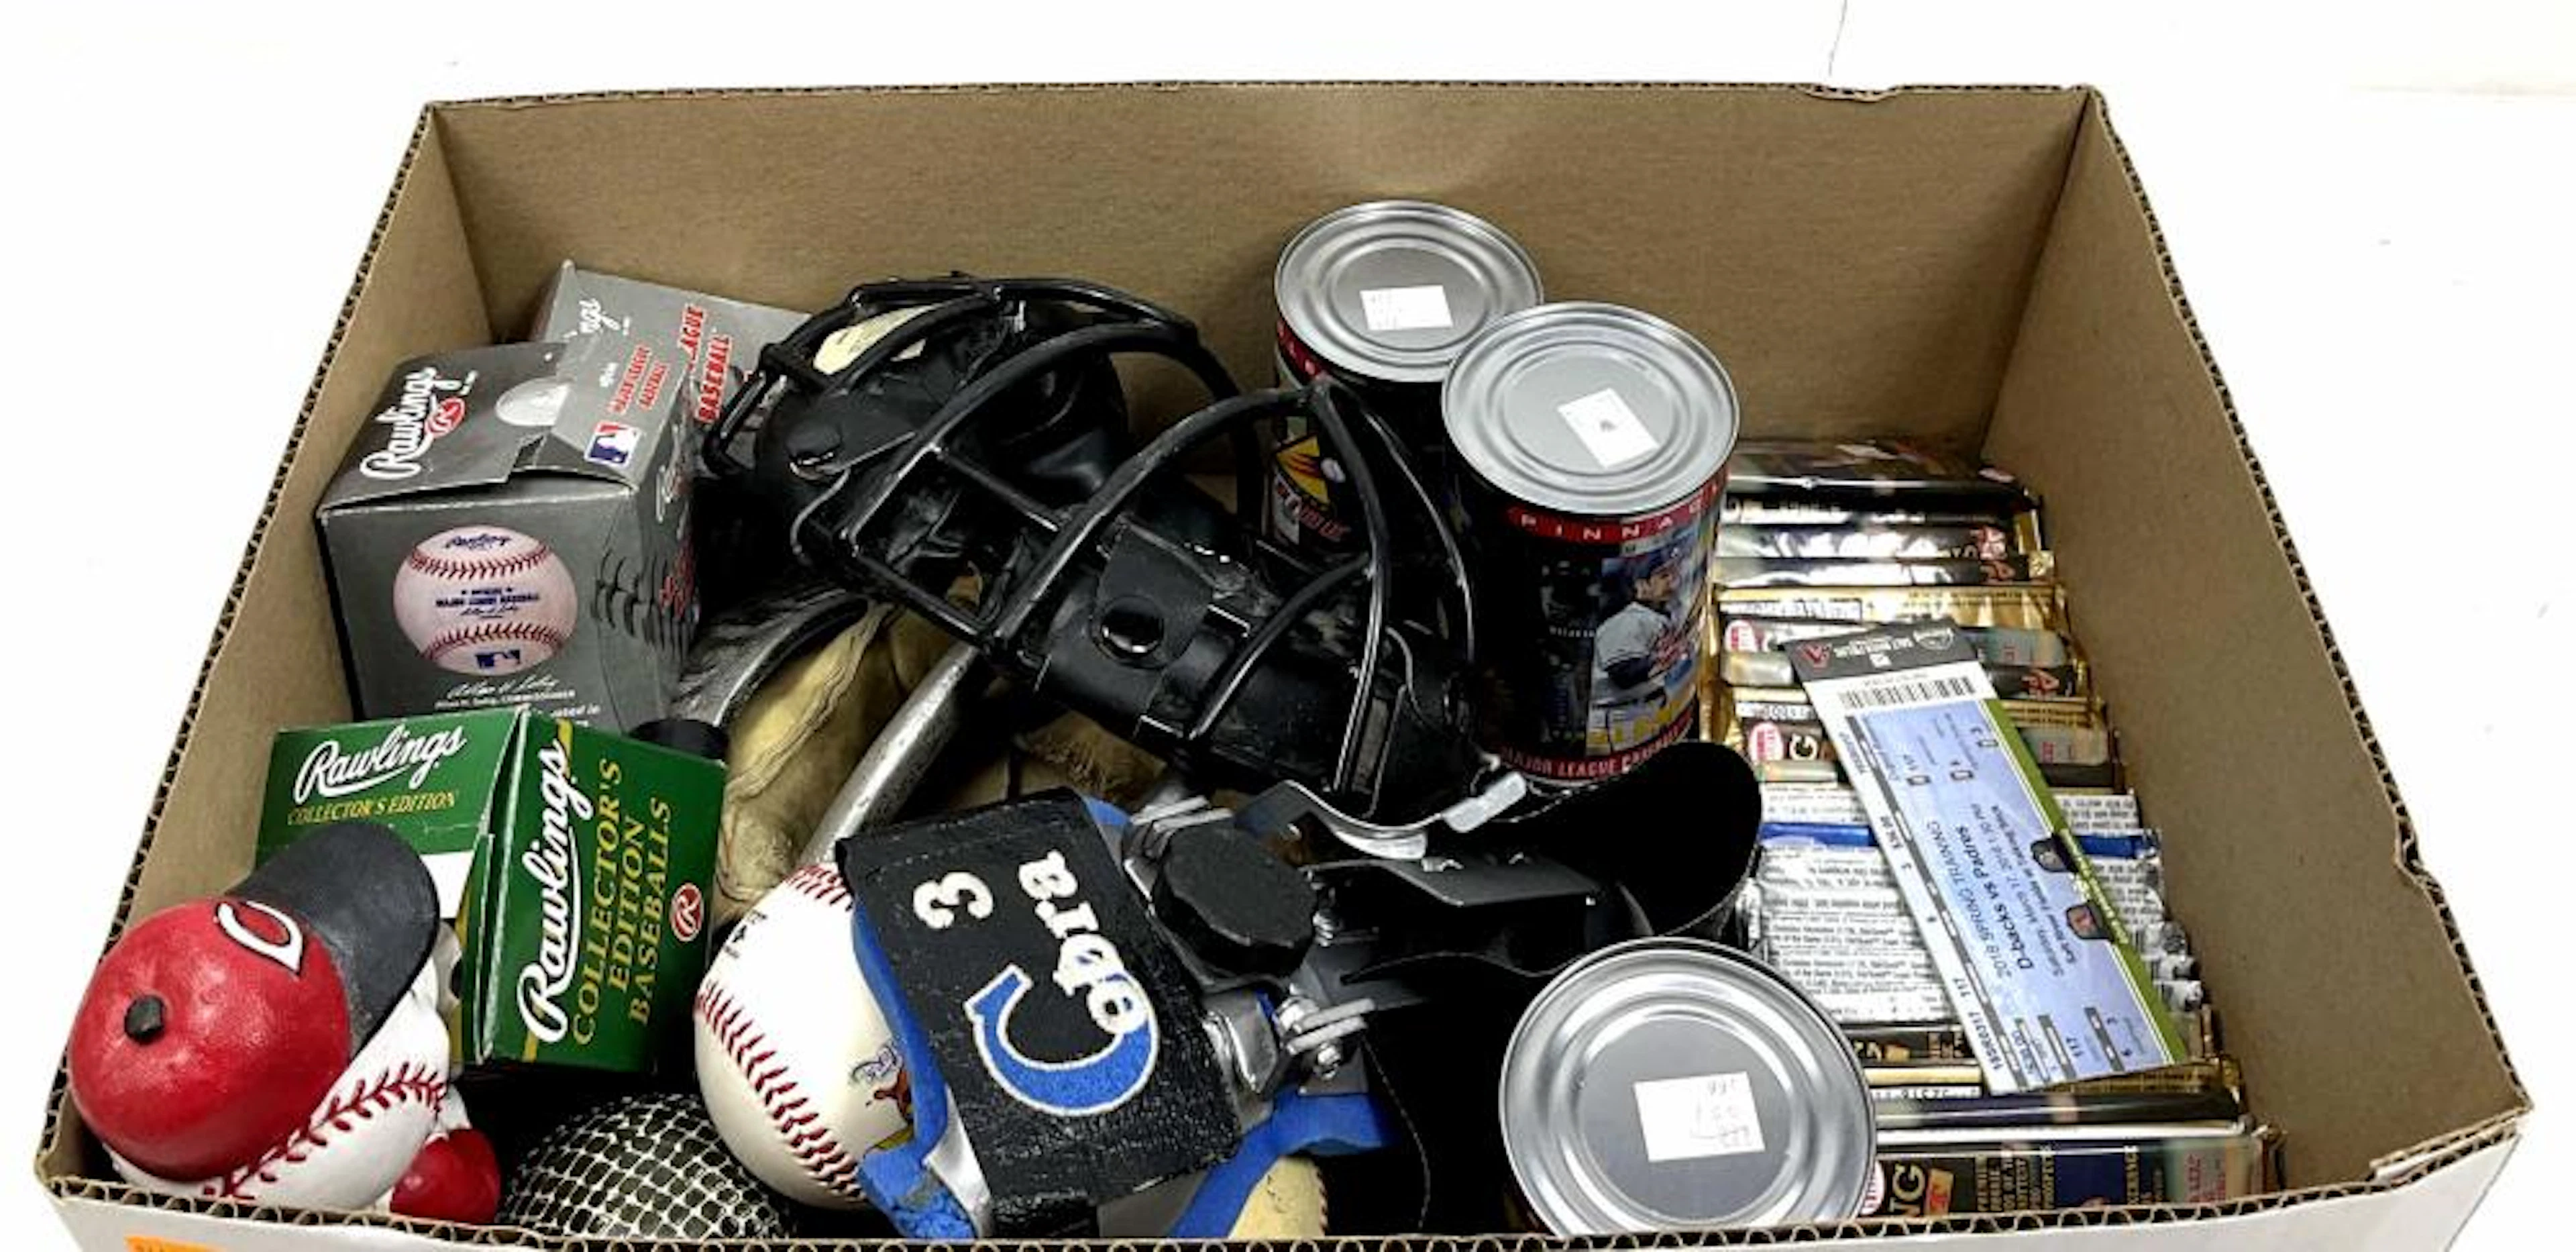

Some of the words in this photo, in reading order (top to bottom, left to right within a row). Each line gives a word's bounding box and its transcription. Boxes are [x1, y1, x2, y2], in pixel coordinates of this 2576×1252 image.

[696, 336, 731, 423] BASEBALL
[360, 367, 464, 480] Rawlings
[293, 724, 468, 804] Rawlings
[286, 796, 387, 826] COLLECTOR'S
[388, 790, 455, 815] EDITION
[517, 738, 594, 1043] Rawlings
[1923, 819, 1968, 885] TRAINING
[1951, 825, 1990, 878] Padres
[1979, 880, 2000, 899] vs
[573, 759, 622, 1046] COLLECTOR'S
[608, 816, 645, 992] EDITION
[629, 797, 671, 1027] BASEBALLS
[1956, 887, 1995, 941] SPRING
[1989, 902, 2035, 970] D-backs
